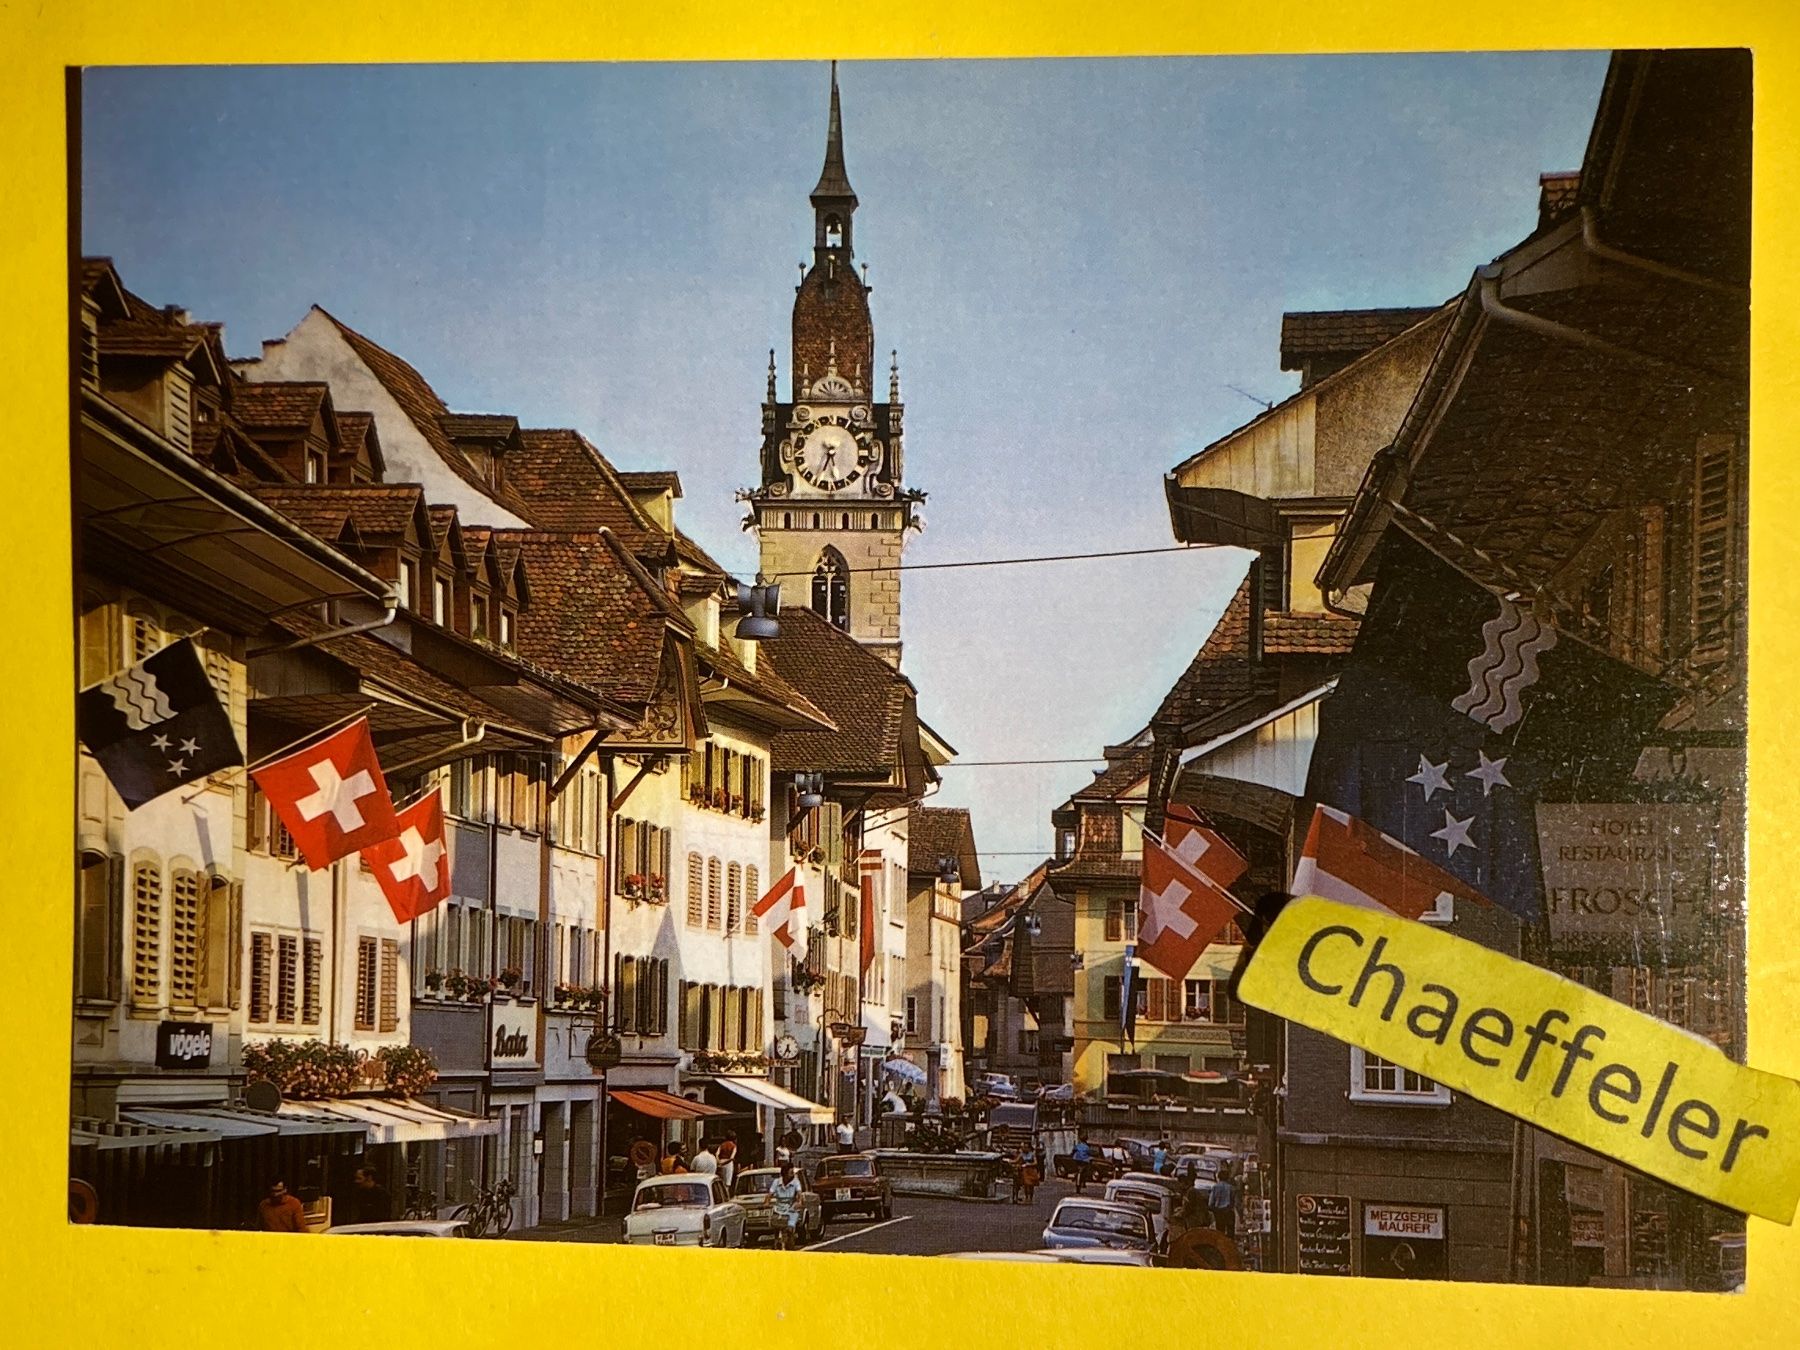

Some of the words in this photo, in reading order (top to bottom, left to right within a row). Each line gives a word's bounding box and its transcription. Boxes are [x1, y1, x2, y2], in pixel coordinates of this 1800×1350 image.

[169, 1028, 211, 1061] vögele
[1298, 925, 1769, 1173] Chaeffeler
[1370, 1209, 1438, 1224] METZGEREI
[1378, 1221, 1432, 1234] MAURER
